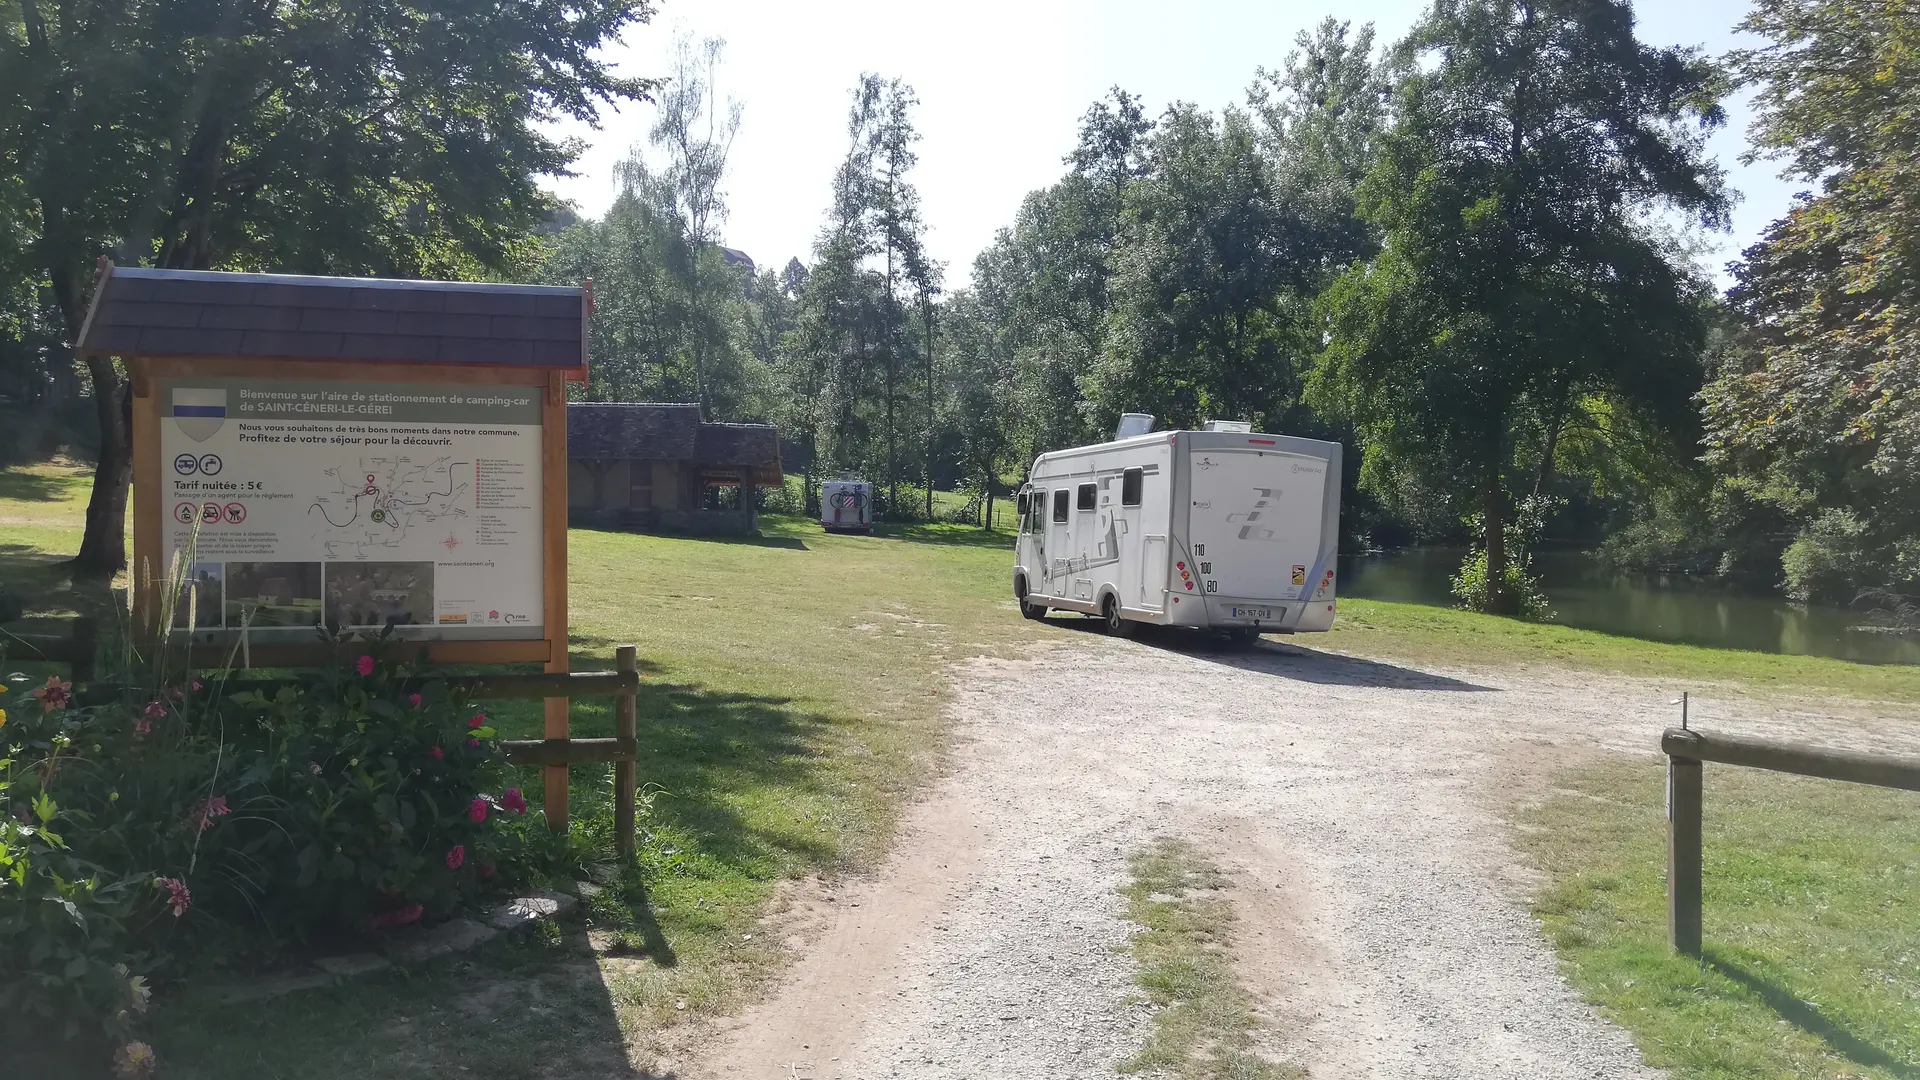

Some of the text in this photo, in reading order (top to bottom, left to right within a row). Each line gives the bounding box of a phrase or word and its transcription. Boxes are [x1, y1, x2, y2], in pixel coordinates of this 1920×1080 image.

[240, 389, 298, 400] Bienvenue
[301, 392, 318, 400] sur
[351, 392, 366, 401] de
[369, 392, 447, 404] stationnement
[449, 394, 463, 404] de
[466, 395, 530, 407] camping-car
[240, 401, 392, 414] de SAINT-CÉNERI-LE-GÉREI
[287, 424, 333, 433] souhaitons
[335, 425, 346, 433] de
[349, 425, 365, 433] très
[390, 427, 429, 435] moments
[431, 427, 451, 435] dans
[239, 434, 280, 443] Profitez
[283, 434, 296, 443] de
[330, 435, 362, 446] séjour
[364, 437, 389, 446] pour
[391, 436, 400, 445] la
[403, 436, 452, 446] découvrir.
[174, 480, 199, 490] Tarif
[202, 481, 237, 490] nuitée
[247, 481, 254, 490] 5
[262, 492, 294, 500] règlement
[1194, 543, 1205, 557] 110
[437, 560, 495, 568] www.saintceneri.org
[1200, 562, 1212, 575] 100
[1206, 580, 1218, 593] 80
